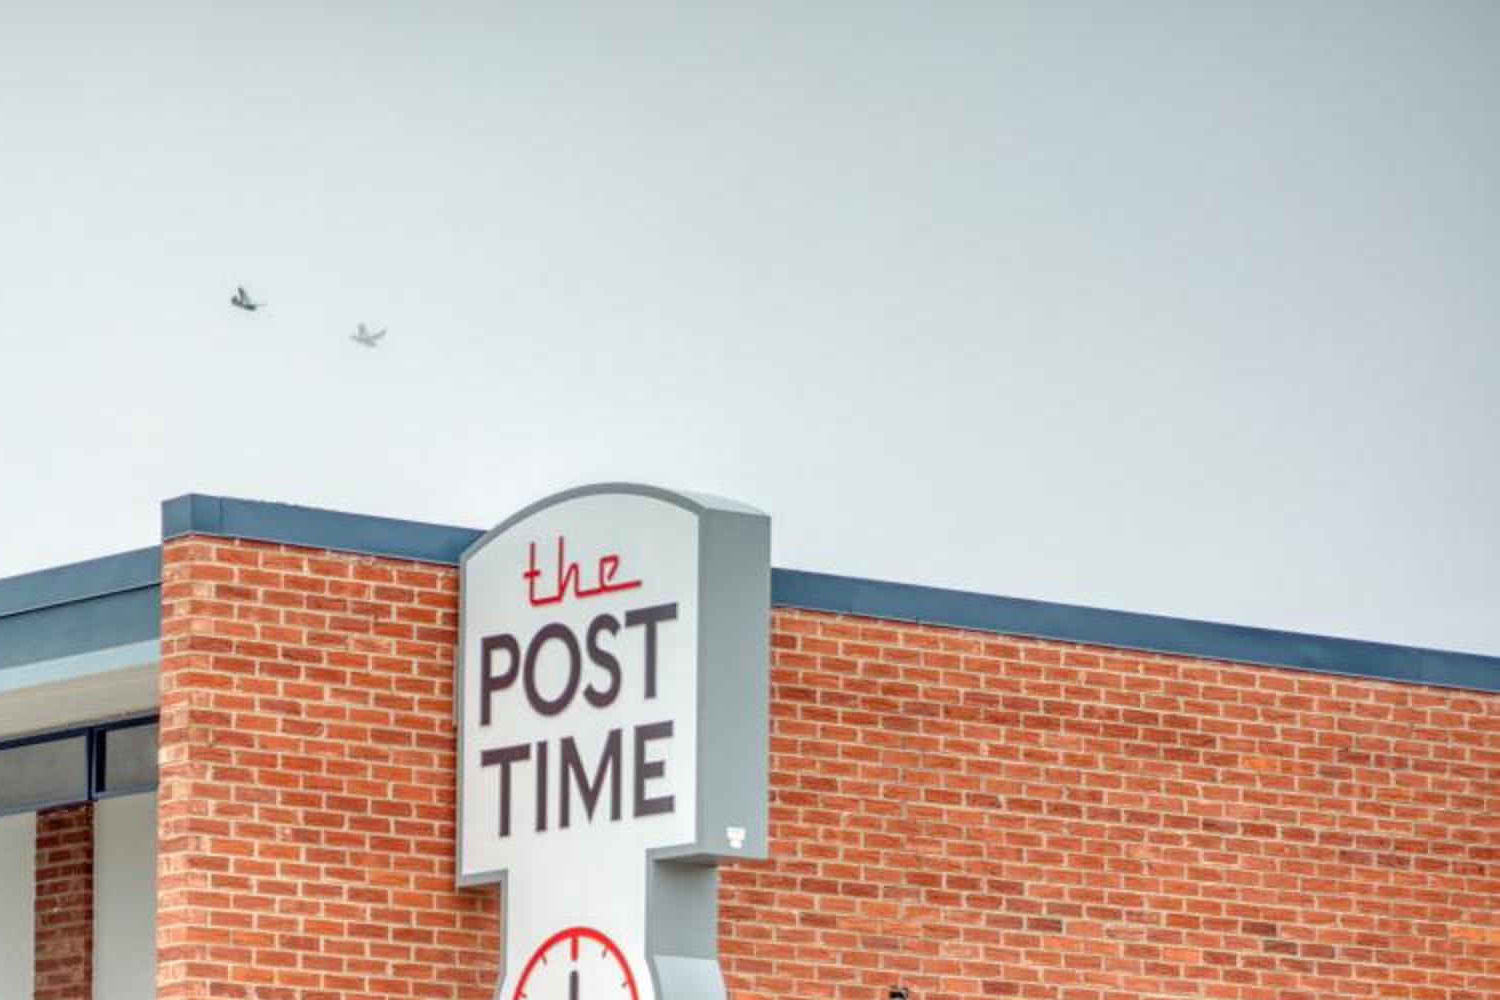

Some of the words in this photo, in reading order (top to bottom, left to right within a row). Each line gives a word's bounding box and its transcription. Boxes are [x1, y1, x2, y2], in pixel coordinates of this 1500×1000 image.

[522, 535, 642, 607] the
[479, 602, 678, 727] POST
[480, 720, 676, 838] TIME
